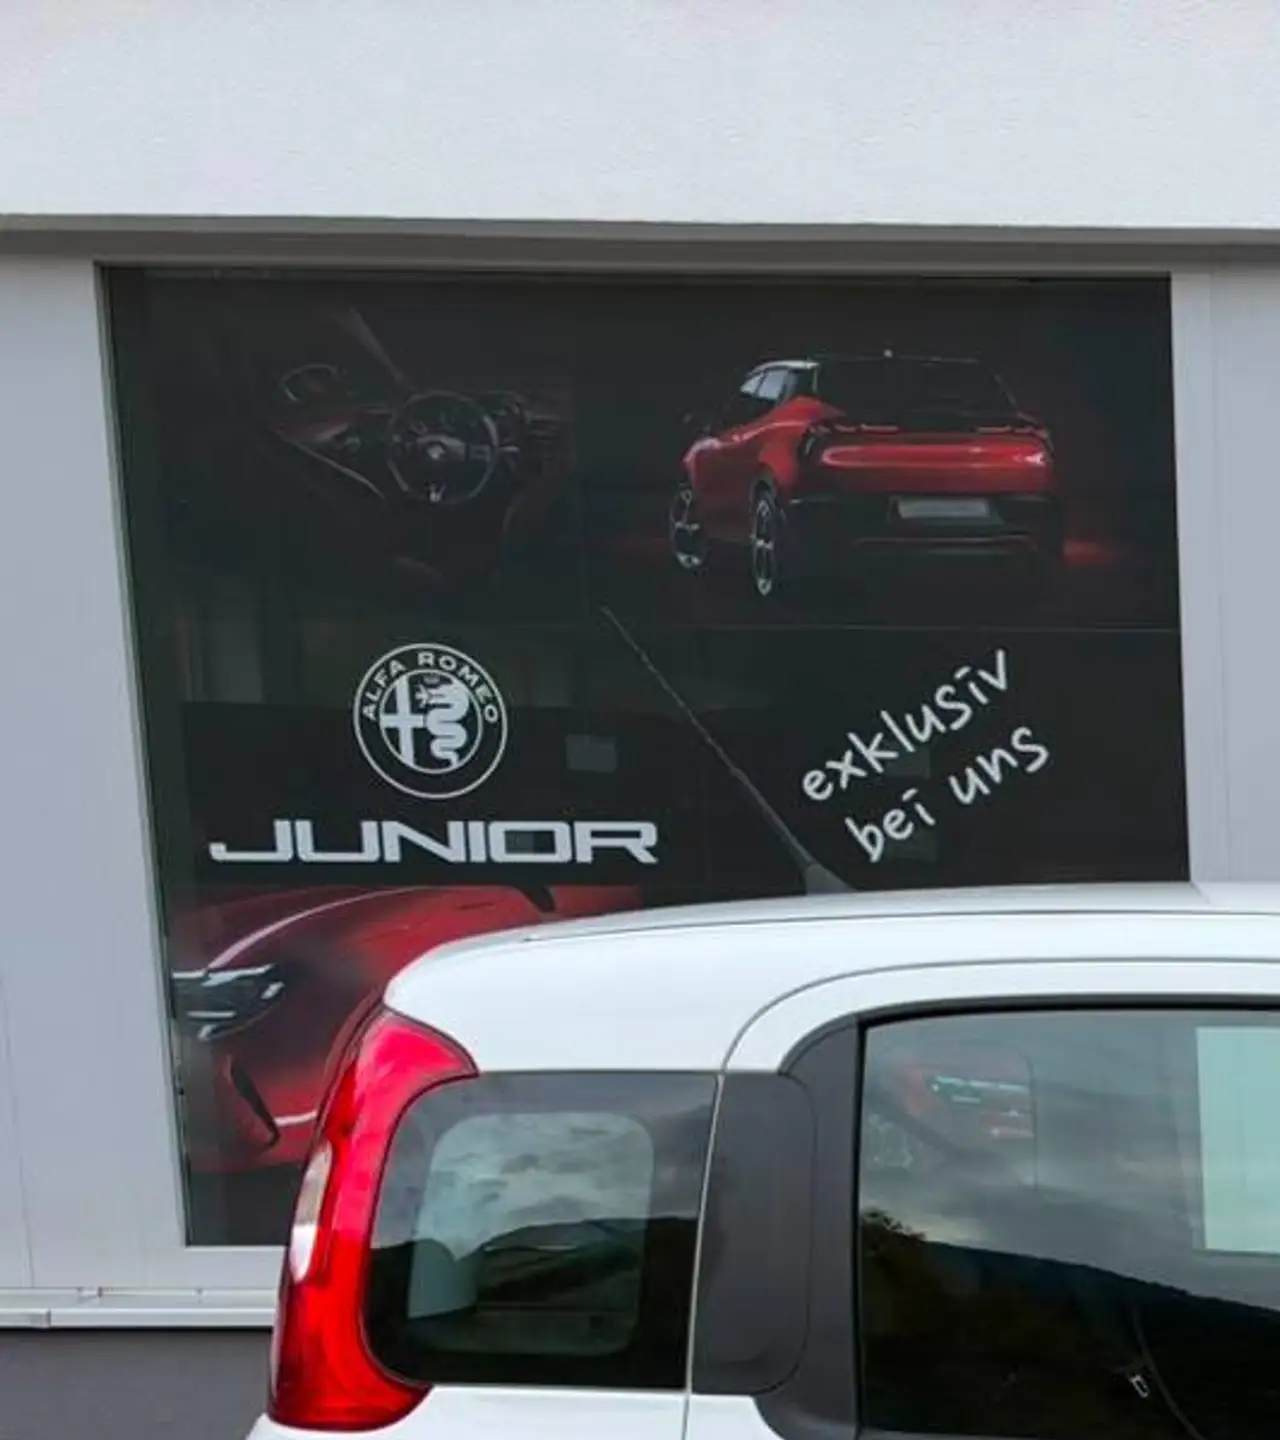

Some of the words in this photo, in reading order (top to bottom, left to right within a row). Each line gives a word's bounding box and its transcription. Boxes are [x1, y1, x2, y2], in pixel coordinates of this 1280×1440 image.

[361, 659, 407, 721] ALFA
[417, 651, 499, 724] ROMEO
[801, 648, 1009, 801] exklusiv
[208, 818, 659, 864] JUNIOR
[844, 788, 936, 864] bei
[947, 726, 1050, 806] uns
